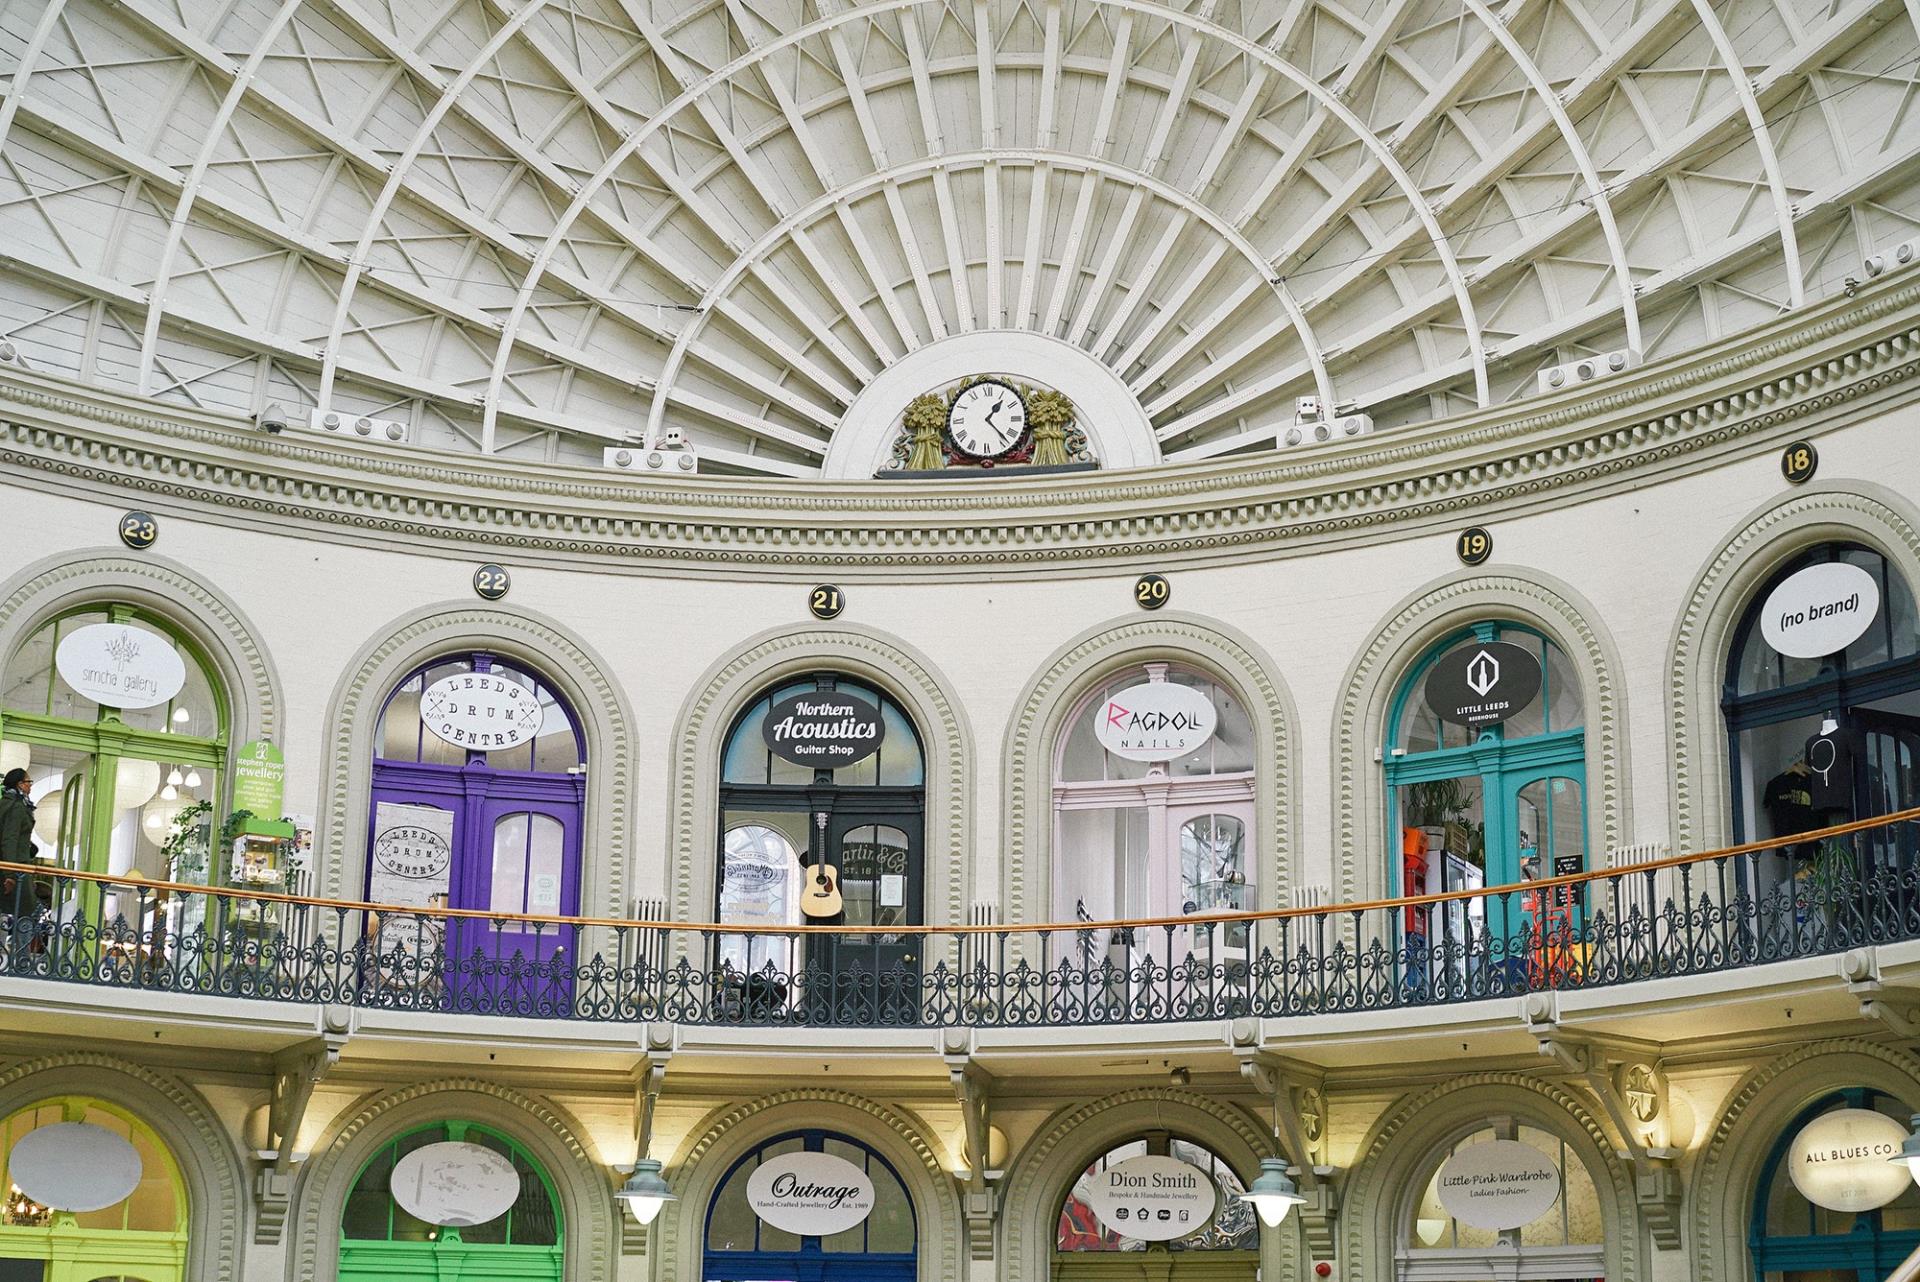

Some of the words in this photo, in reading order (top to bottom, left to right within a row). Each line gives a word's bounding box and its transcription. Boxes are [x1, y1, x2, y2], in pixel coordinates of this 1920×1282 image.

[1787, 449, 1810, 474] 18
[125, 519, 155, 540] 23
[1463, 535, 1486, 556] 19
[479, 572, 506, 590] 22
[1138, 581, 1166, 600] 20
[814, 591, 838, 609] 21
[1780, 613, 1804, 632] (no
[1809, 593, 1859, 621] brand)
[82, 668, 117, 687] simcha
[124, 674, 158, 697] gallery
[448, 678, 520, 699] LEEDS
[449, 702, 514, 720] DRUM
[796, 702, 854, 716] Northern
[1456, 705, 1482, 715] LITTLE
[1485, 701, 1510, 711] LEEDS
[1105, 702, 1204, 737] RAGDOLL
[1468, 713, 1499, 722] BEERHOUSE
[441, 723, 519, 745] CENTRE
[773, 716, 876, 742] Acoustics
[795, 745, 826, 754] Guitar
[828, 745, 855, 756] Shop
[1121, 739, 1185, 748] NAILS
[392, 830, 436, 844] LEEDS
[393, 846, 432, 858] DRUM
[388, 860, 435, 875] CENTRE
[1806, 1152, 1827, 1164] ALL
[1832, 1146, 1869, 1160] BLUES
[1874, 1144, 1898, 1155] CO.
[1110, 1171, 1146, 1187] Dion
[1152, 1172, 1197, 1188] Smith
[1443, 1175, 1471, 1187] Little
[1471, 1173, 1498, 1185] Pink
[1499, 1170, 1553, 1182] Wardrobe
[771, 1172, 860, 1209] Outrage
[1109, 1191, 1132, 1199] Bespoke
[1171, 1192, 1199, 1200] Jewellery
[1470, 1188, 1494, 1198] Ladies
[1496, 1187, 1530, 1196] Fashion
[800, 1201, 828, 1210] Jewellery
